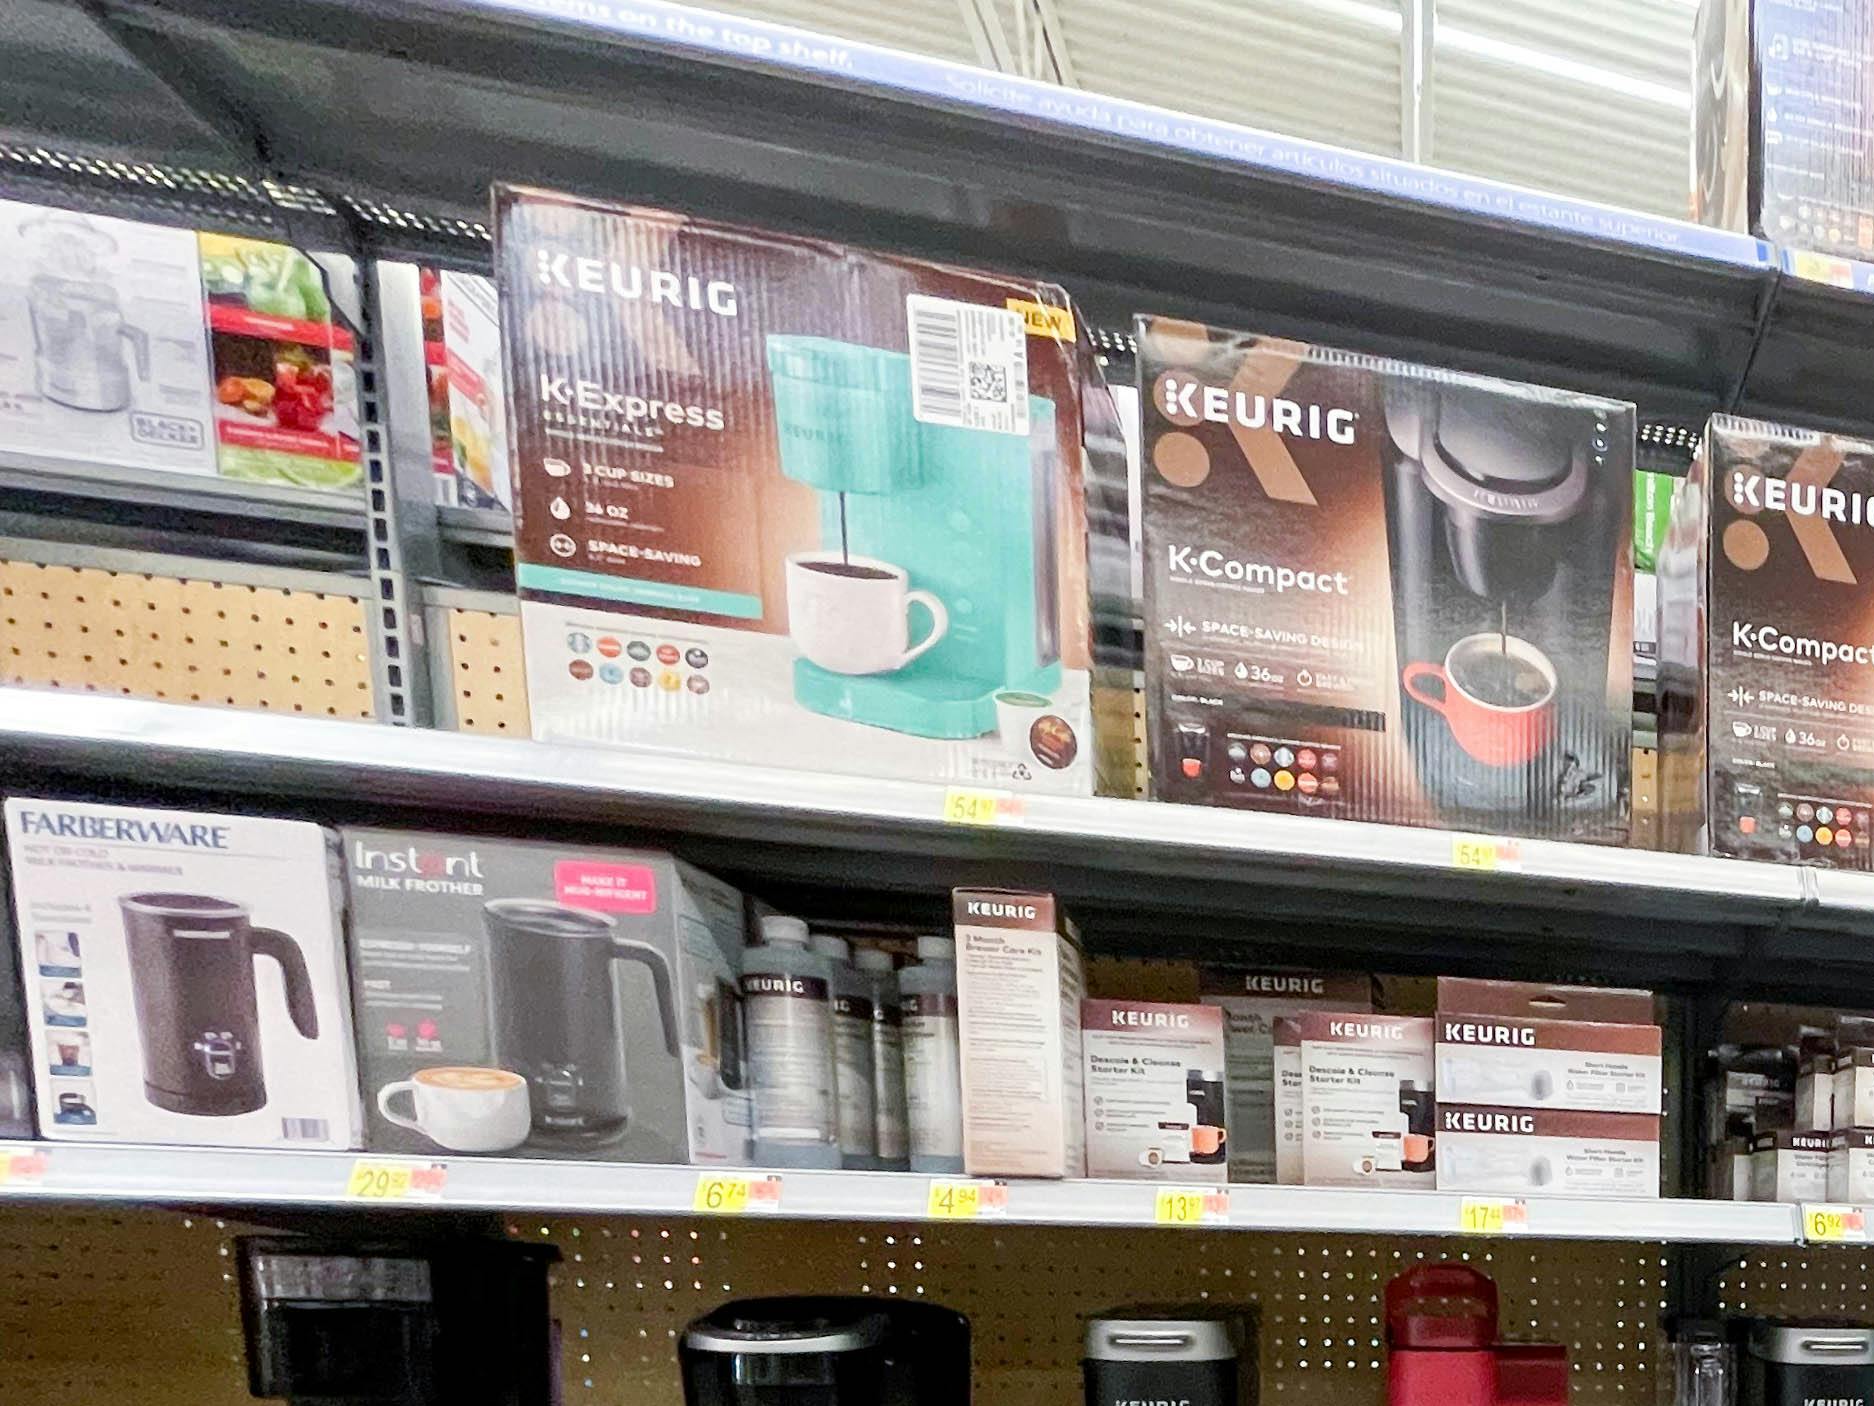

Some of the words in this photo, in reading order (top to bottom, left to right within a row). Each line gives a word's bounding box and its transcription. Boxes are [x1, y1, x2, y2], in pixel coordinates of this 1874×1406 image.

[665, 17, 713, 38] the
[723, 28, 773, 51] top
[781, 41, 854, 68] shelf.
[1118, 113, 1169, 141] para
[1175, 121, 1264, 157] obtener
[1370, 160, 1459, 199] situados
[536, 249, 738, 316] KEURIG
[1166, 378, 1358, 446] KEURIG
[595, 465, 627, 480] CUP
[1201, 620, 1308, 645] SPACE-SAVING
[1759, 690, 1847, 711] SPACE-SAVING
[20, 811, 231, 849] FARBERWARE
[356, 875, 400, 891] MILK
[405, 877, 484, 897] FROTHER
[968, 901, 1036, 920] KEURIG
[1245, 975, 1324, 994] KEURIG
[1112, 1009, 1190, 1029] KEURIG
[1330, 1021, 1403, 1040] KEURIG
[1445, 1023, 1536, 1046] KEURIG
[1445, 1111, 1535, 1133] KEURIG
[1792, 1136, 1828, 1149] KEURI
